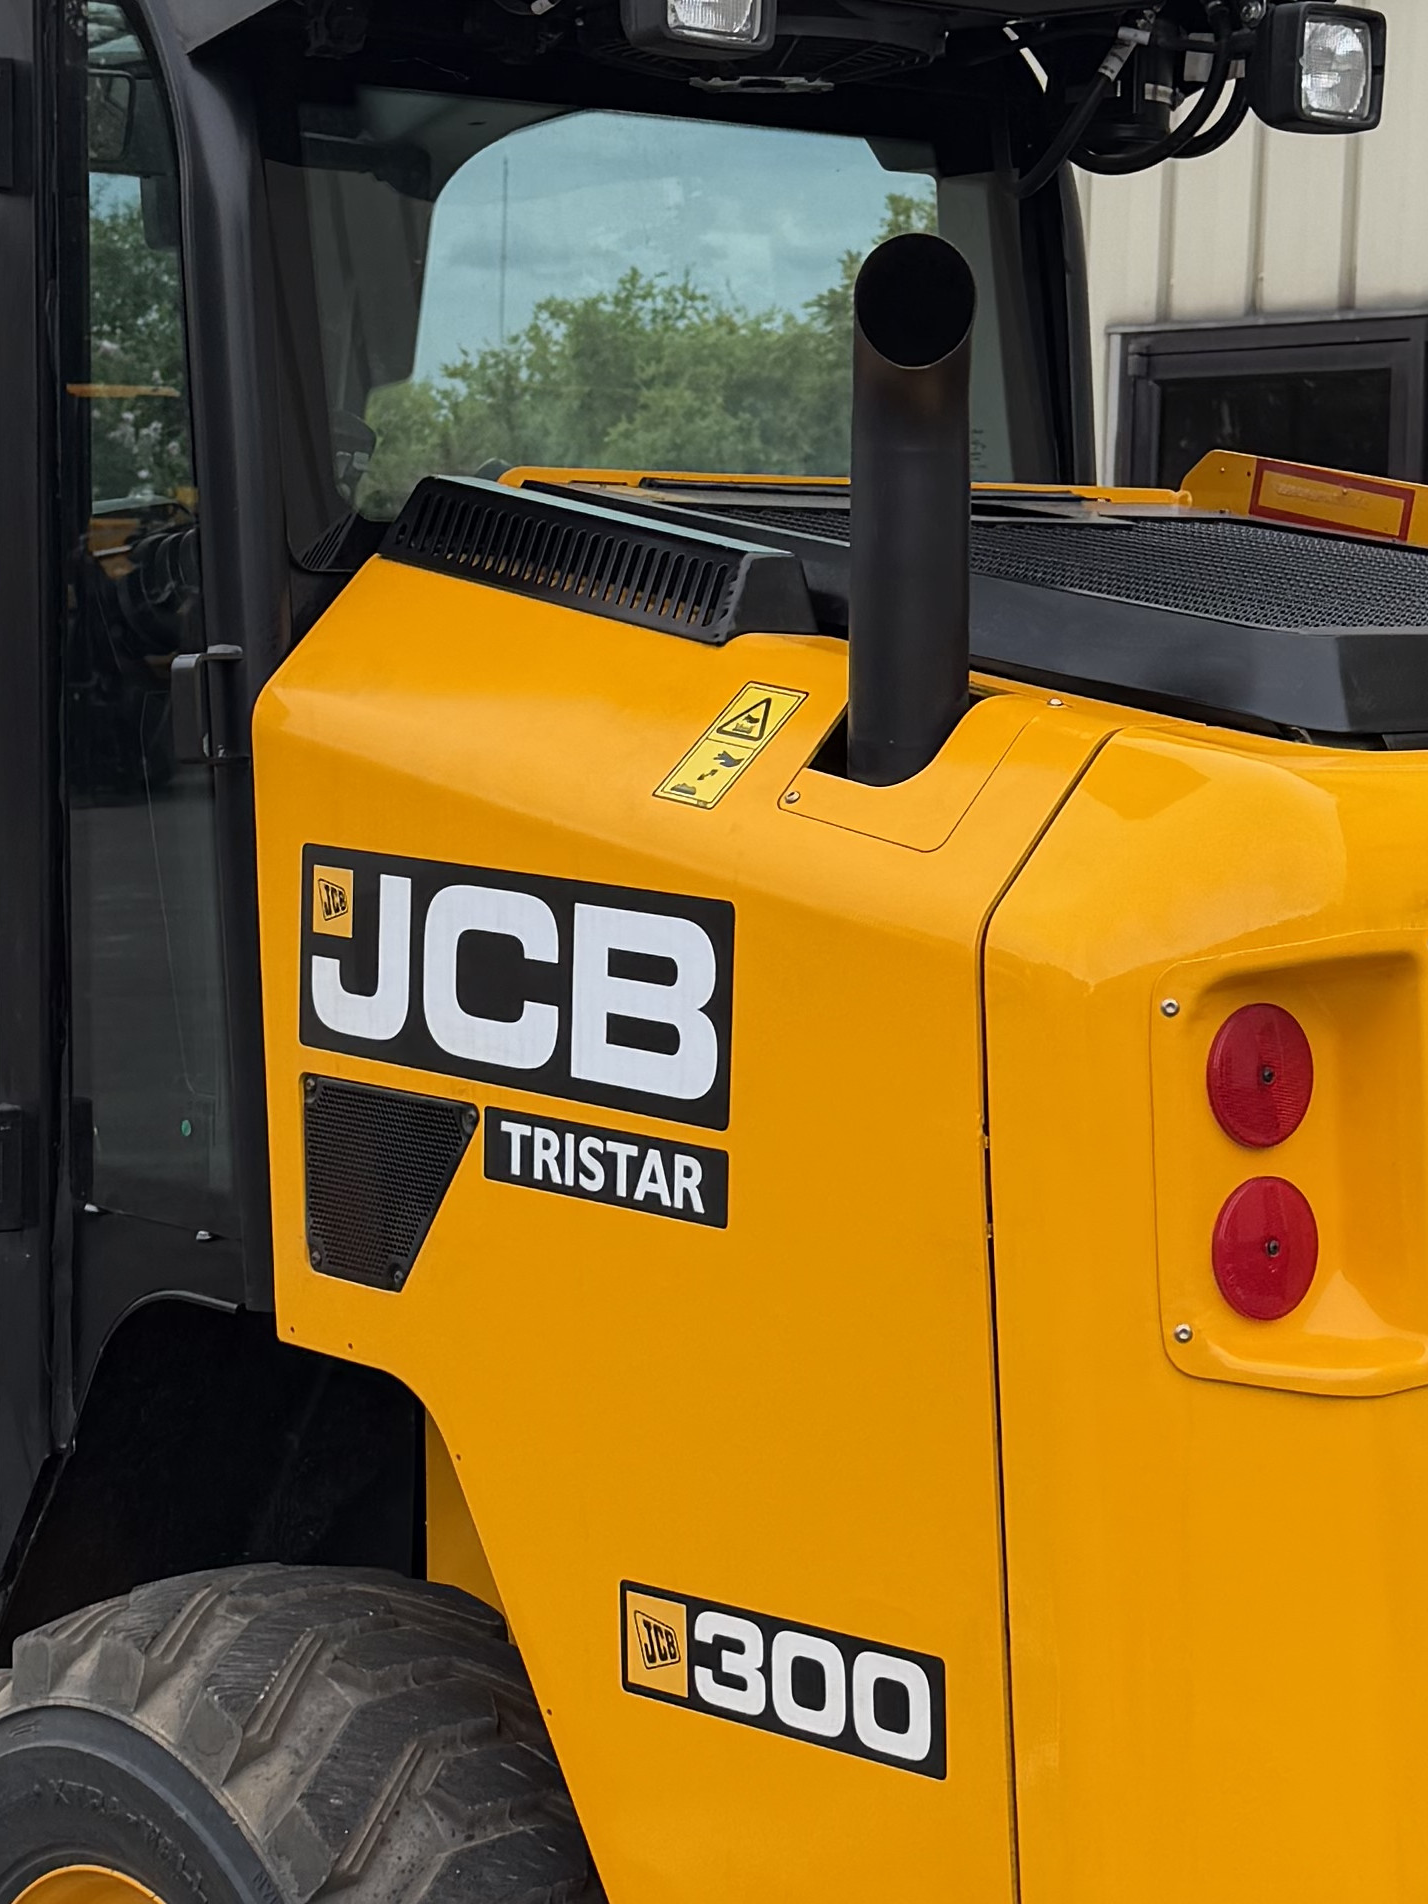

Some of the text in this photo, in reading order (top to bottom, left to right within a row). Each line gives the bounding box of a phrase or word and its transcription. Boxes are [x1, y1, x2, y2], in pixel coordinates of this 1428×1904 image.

[323, 884, 347, 916] JCB
[311, 873, 718, 1100] JCB
[500, 1120, 705, 1214] TRISTAR
[642, 1611, 932, 1761] JCB 300
